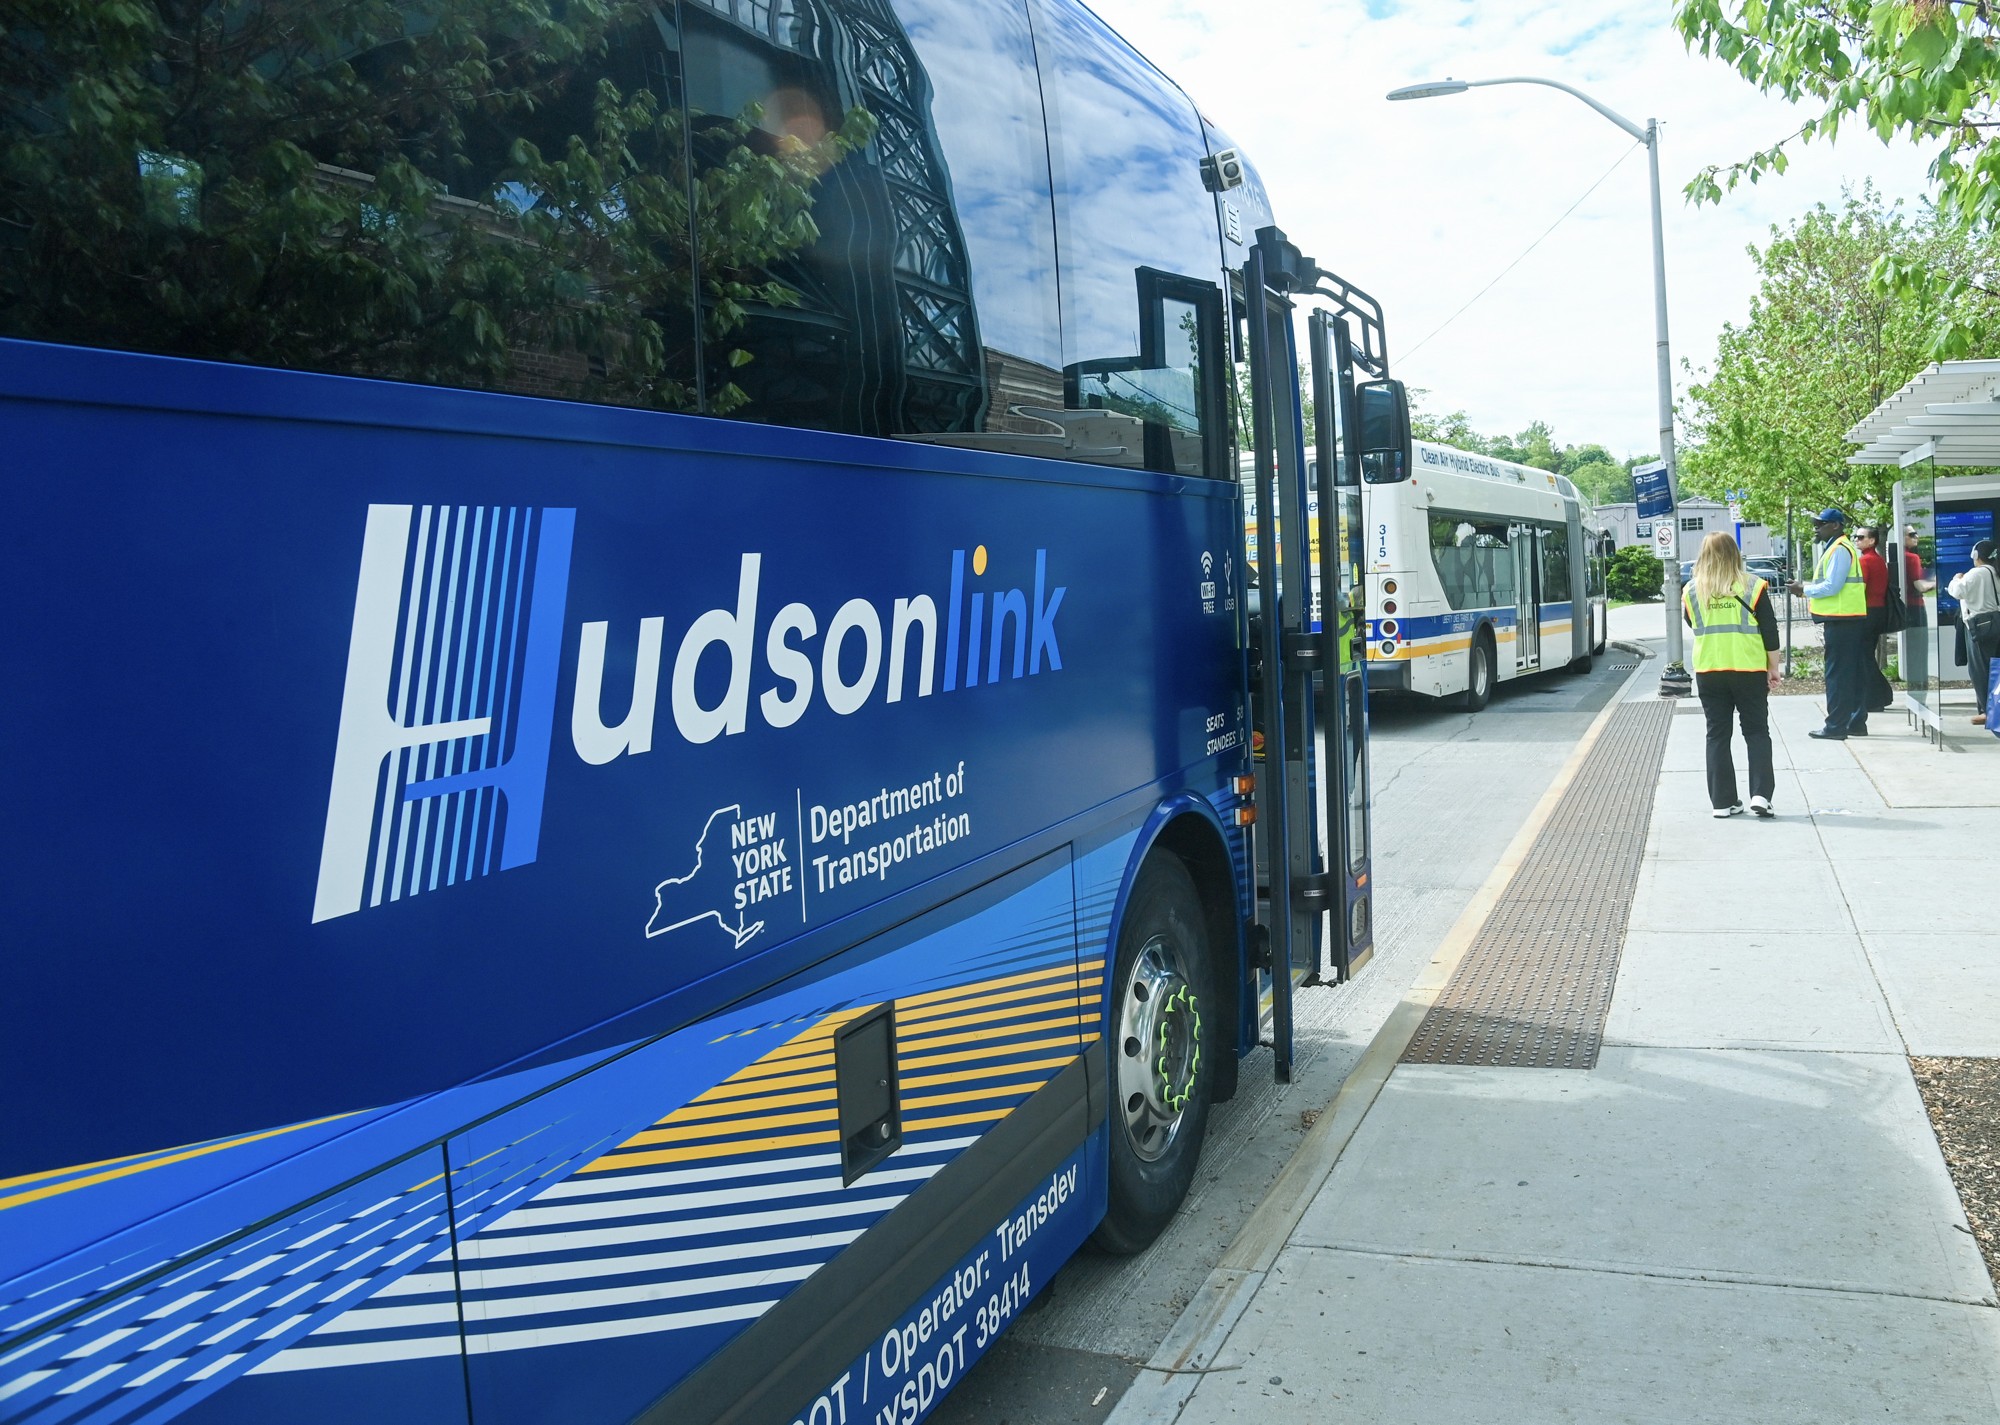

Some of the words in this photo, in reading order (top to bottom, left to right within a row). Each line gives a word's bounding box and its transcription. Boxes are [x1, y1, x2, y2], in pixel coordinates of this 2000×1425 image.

[1421, 447, 1440, 466] Clean
[1440, 452, 1449, 467] Air
[1449, 454, 1469, 473] Hybrid
[1469, 458, 1490, 476] Electric
[1490, 463, 1501, 478] Bus
[1202, 584, 1215, 598] Wi-Fi
[1203, 600, 1215, 615] FREE
[1224, 598, 1235, 611] USB
[1206, 712, 1225, 733] SEATS
[1206, 730, 1236, 756] STANDEES
[810, 771, 943, 845] Department
[945, 760, 966, 798] of
[731, 811, 776, 850] NEW
[731, 837, 788, 879] YORK
[812, 812, 971, 894] Transportation
[734, 865, 793, 910] STATE
[881, 1249, 990, 1378] Operator:
[996, 1163, 1078, 1263] Transdev
[875, 1323, 968, 1425] YSDOT
[975, 1260, 1031, 1349] 38414
